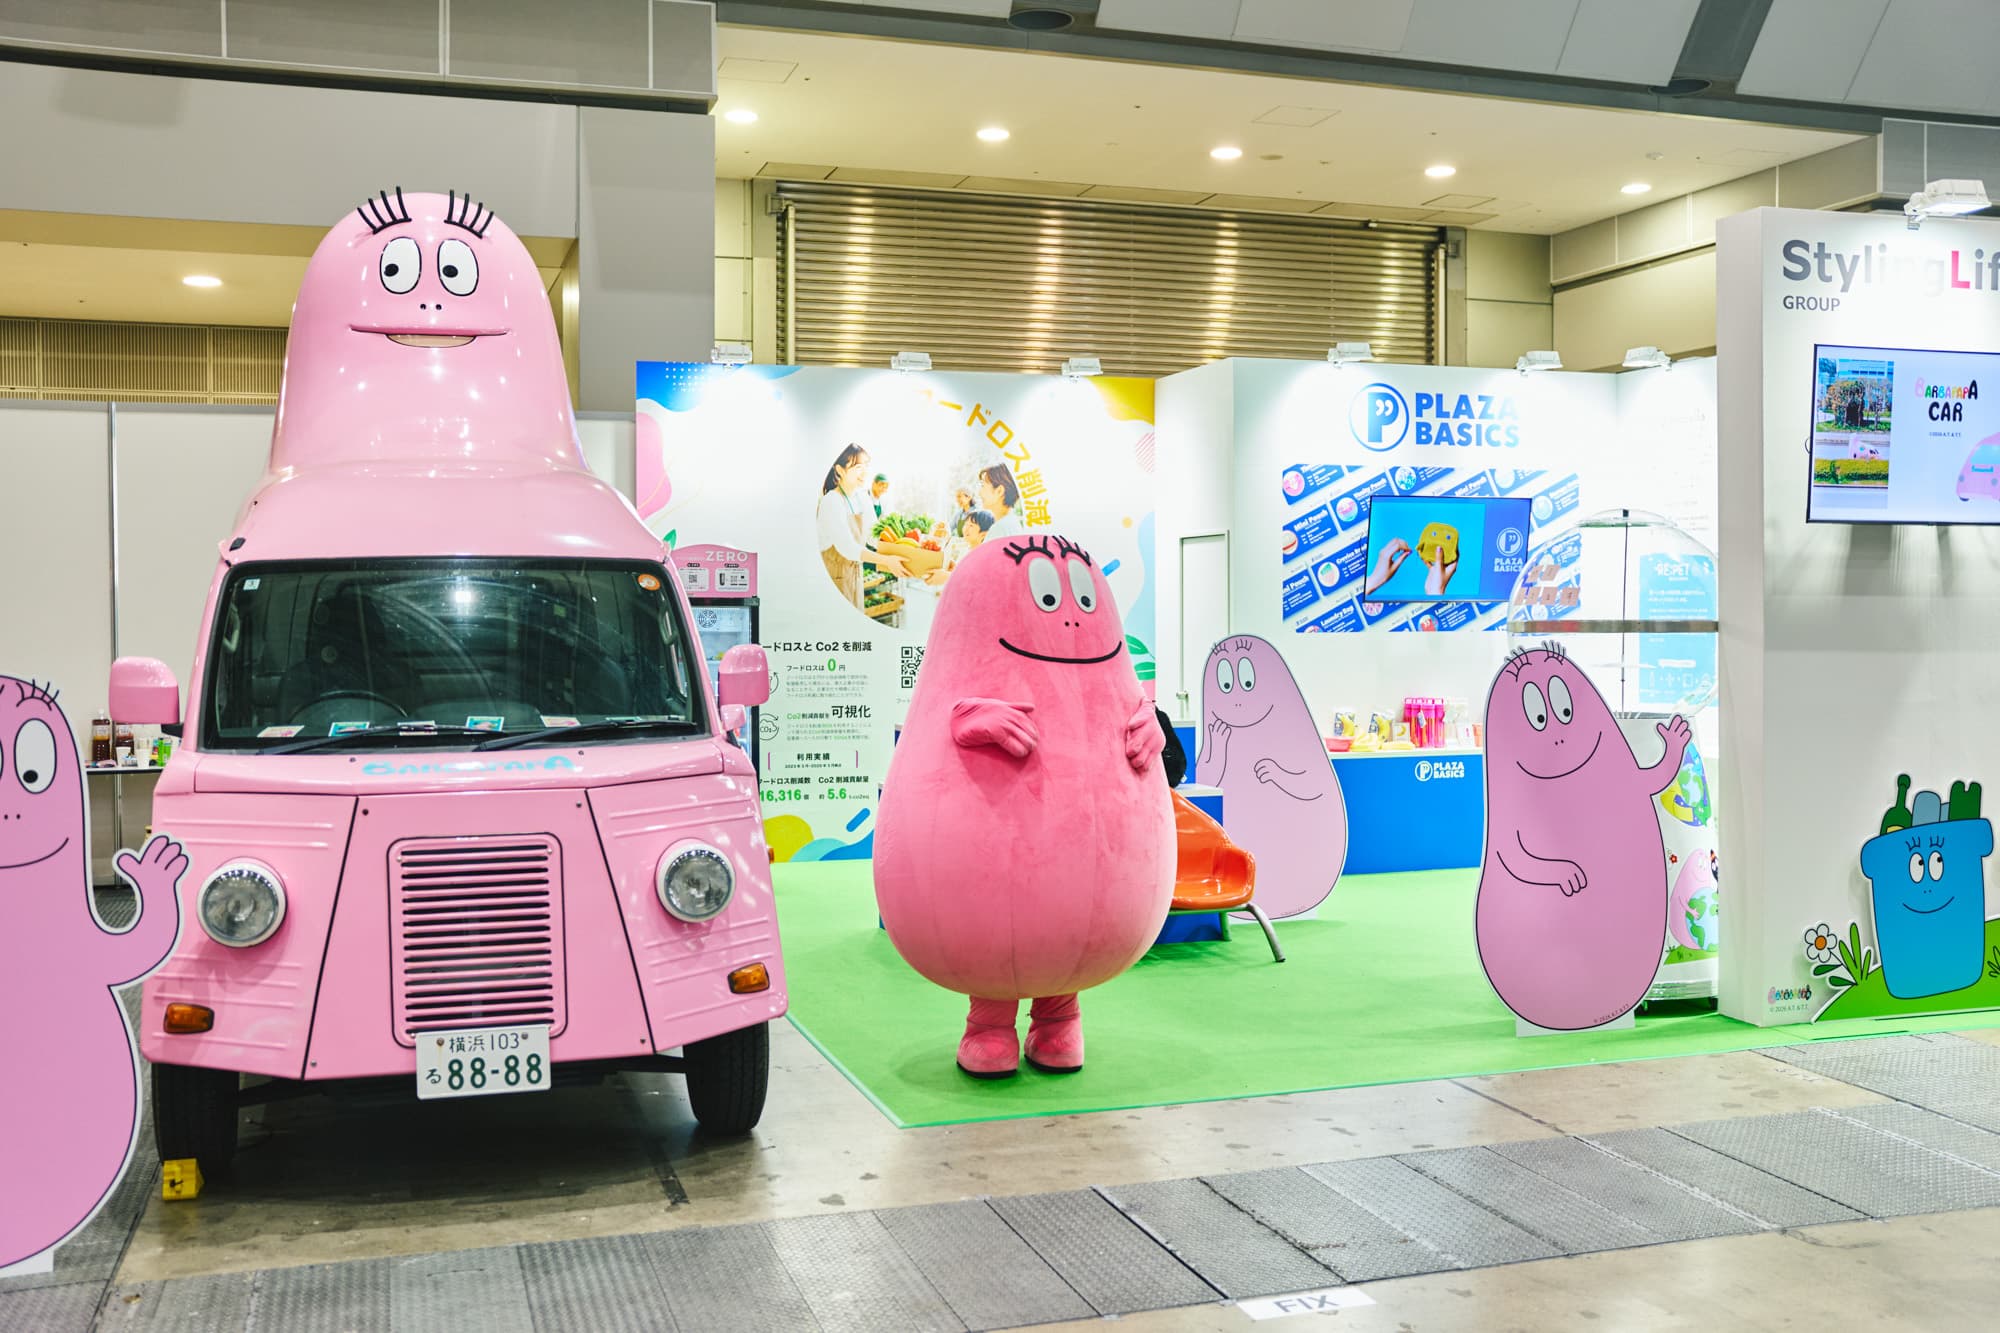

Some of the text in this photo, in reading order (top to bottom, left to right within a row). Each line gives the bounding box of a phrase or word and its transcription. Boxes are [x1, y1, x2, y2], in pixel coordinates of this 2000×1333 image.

[1783, 295, 1841, 312] GROUP
[1415, 393, 1520, 420] PLAZA
[1928, 401, 1963, 422] CAR
[1415, 421, 1520, 448] BASICS
[705, 551, 748, 562] ZERO
[1494, 557, 1523, 565] PLAZA
[816, 641, 840, 652] Co2
[831, 704, 872, 719] 可視化
[1434, 762, 1465, 771] PLAZA
[1434, 769, 1465, 778] BASICS
[449, 1032, 520, 1053] 横浜 103
[425, 1053, 543, 1091] る 88-88
[1273, 1294, 1339, 1313] FIX
